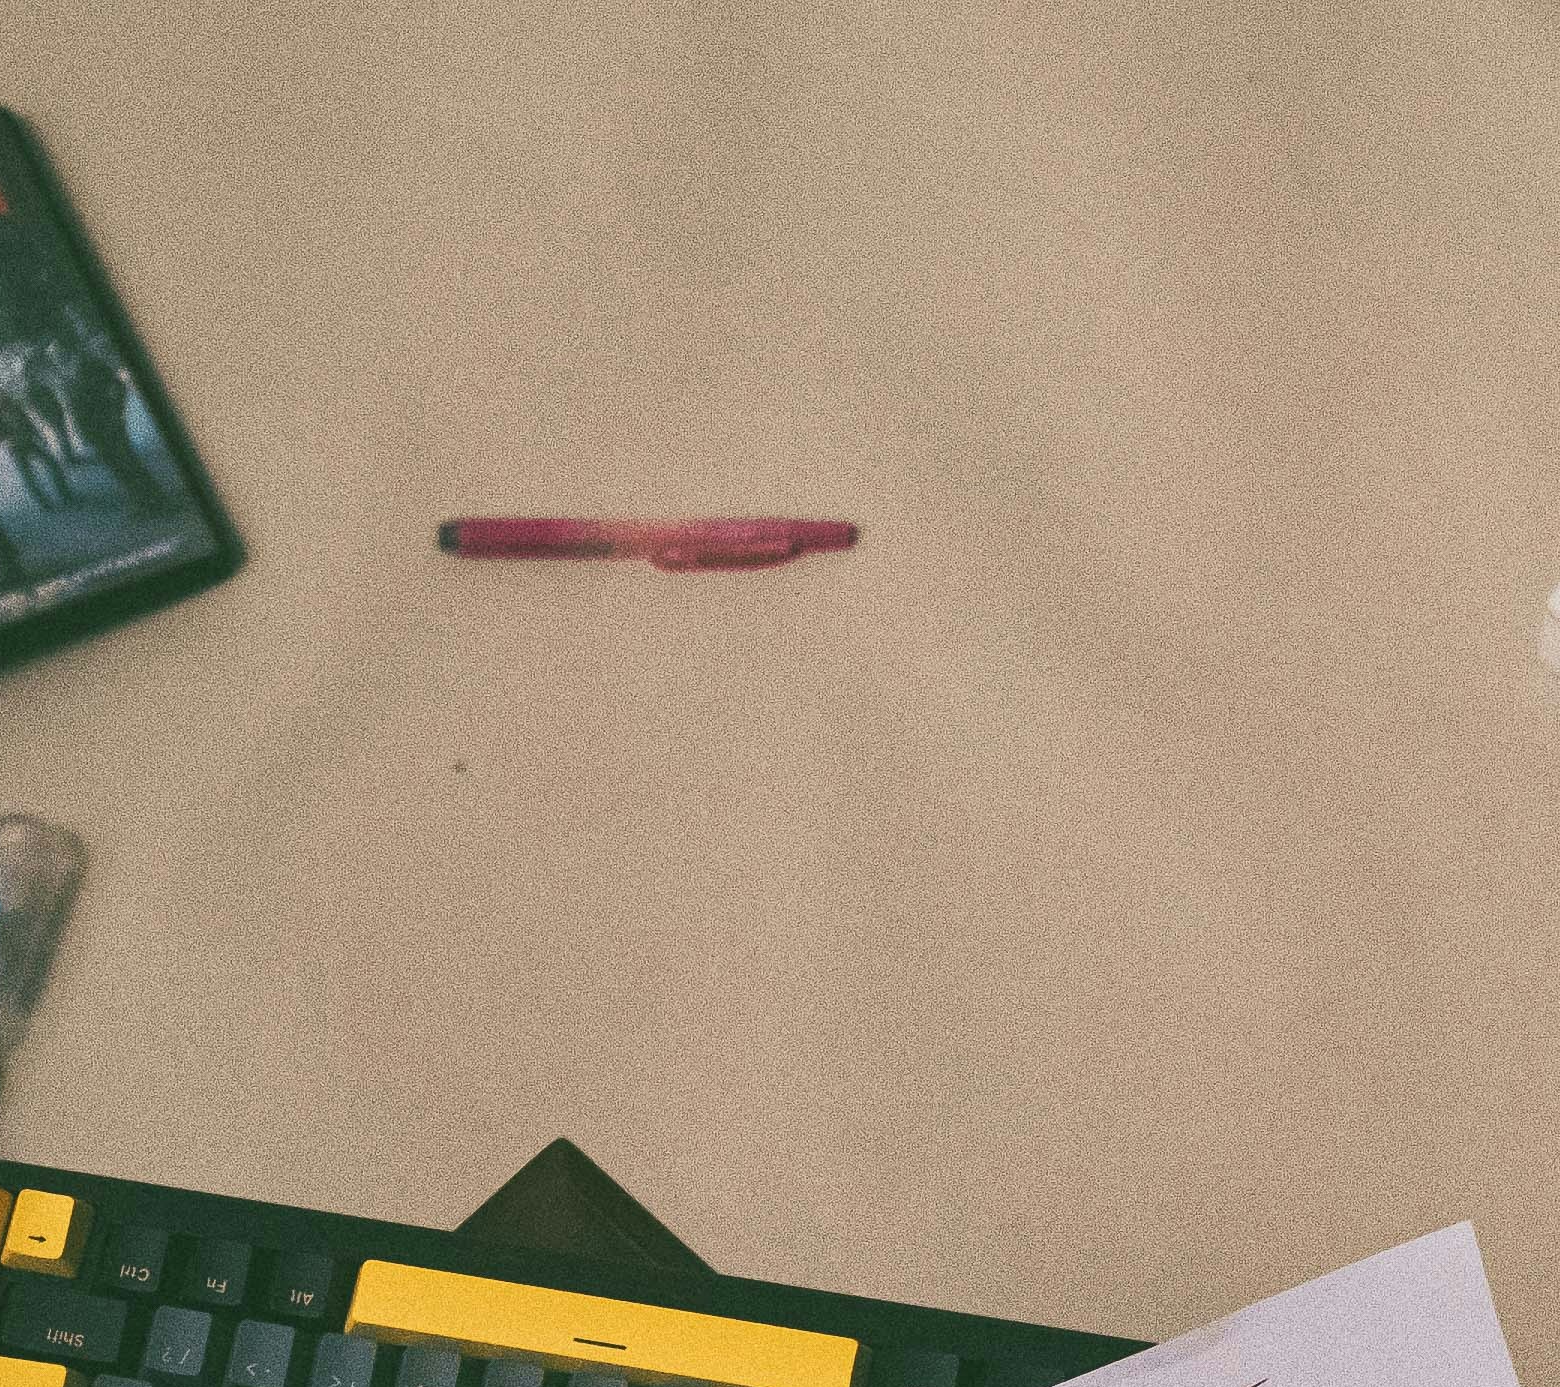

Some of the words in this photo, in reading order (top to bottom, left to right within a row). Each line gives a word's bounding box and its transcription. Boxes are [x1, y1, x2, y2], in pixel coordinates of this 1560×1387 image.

[118, 1261, 151, 1283] Ctrl
[204, 1275, 227, 1293] Fn
[288, 1286, 315, 1307] Alt
[44, 1326, 85, 1348] Shift
